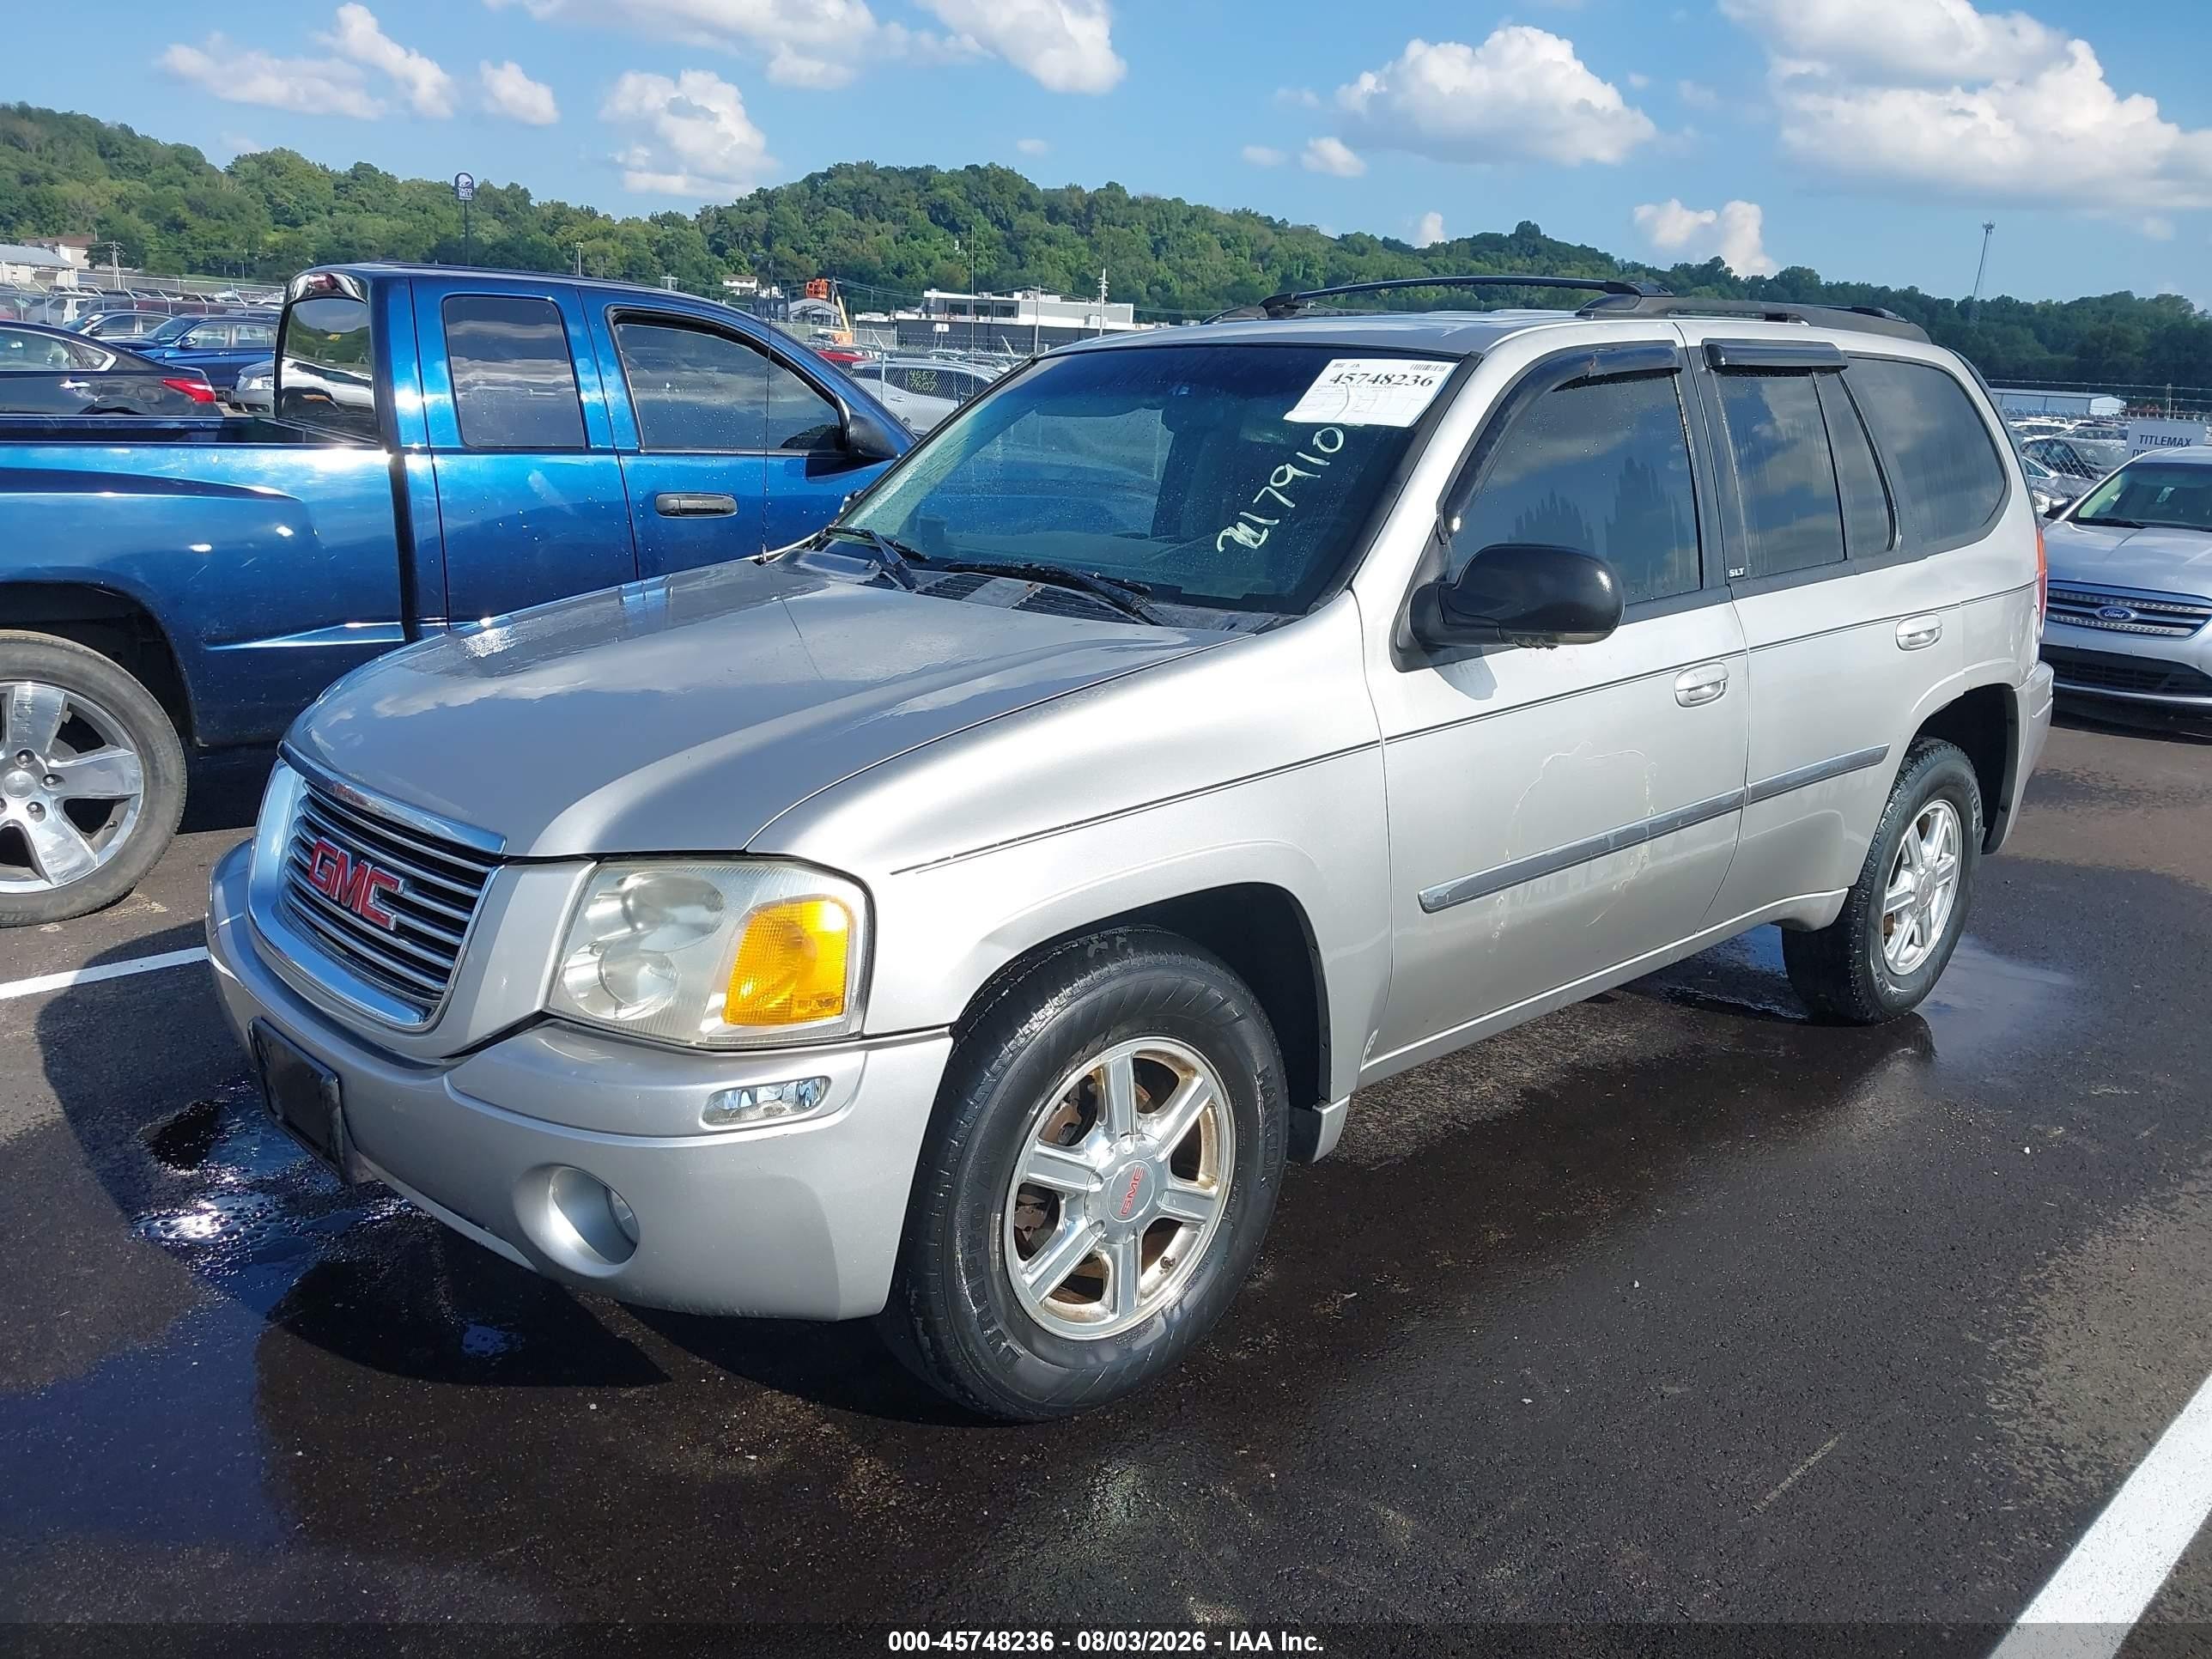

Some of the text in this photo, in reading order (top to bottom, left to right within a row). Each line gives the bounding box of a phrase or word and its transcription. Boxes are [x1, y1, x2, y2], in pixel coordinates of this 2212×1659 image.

[1329, 373, 1434, 387] 45748236
[2138, 434, 2192, 447] TITLEMAX
[1729, 567, 1745, 577] SLT
[308, 836, 404, 931] GMC
[1121, 1164, 1145, 1217] GMC
